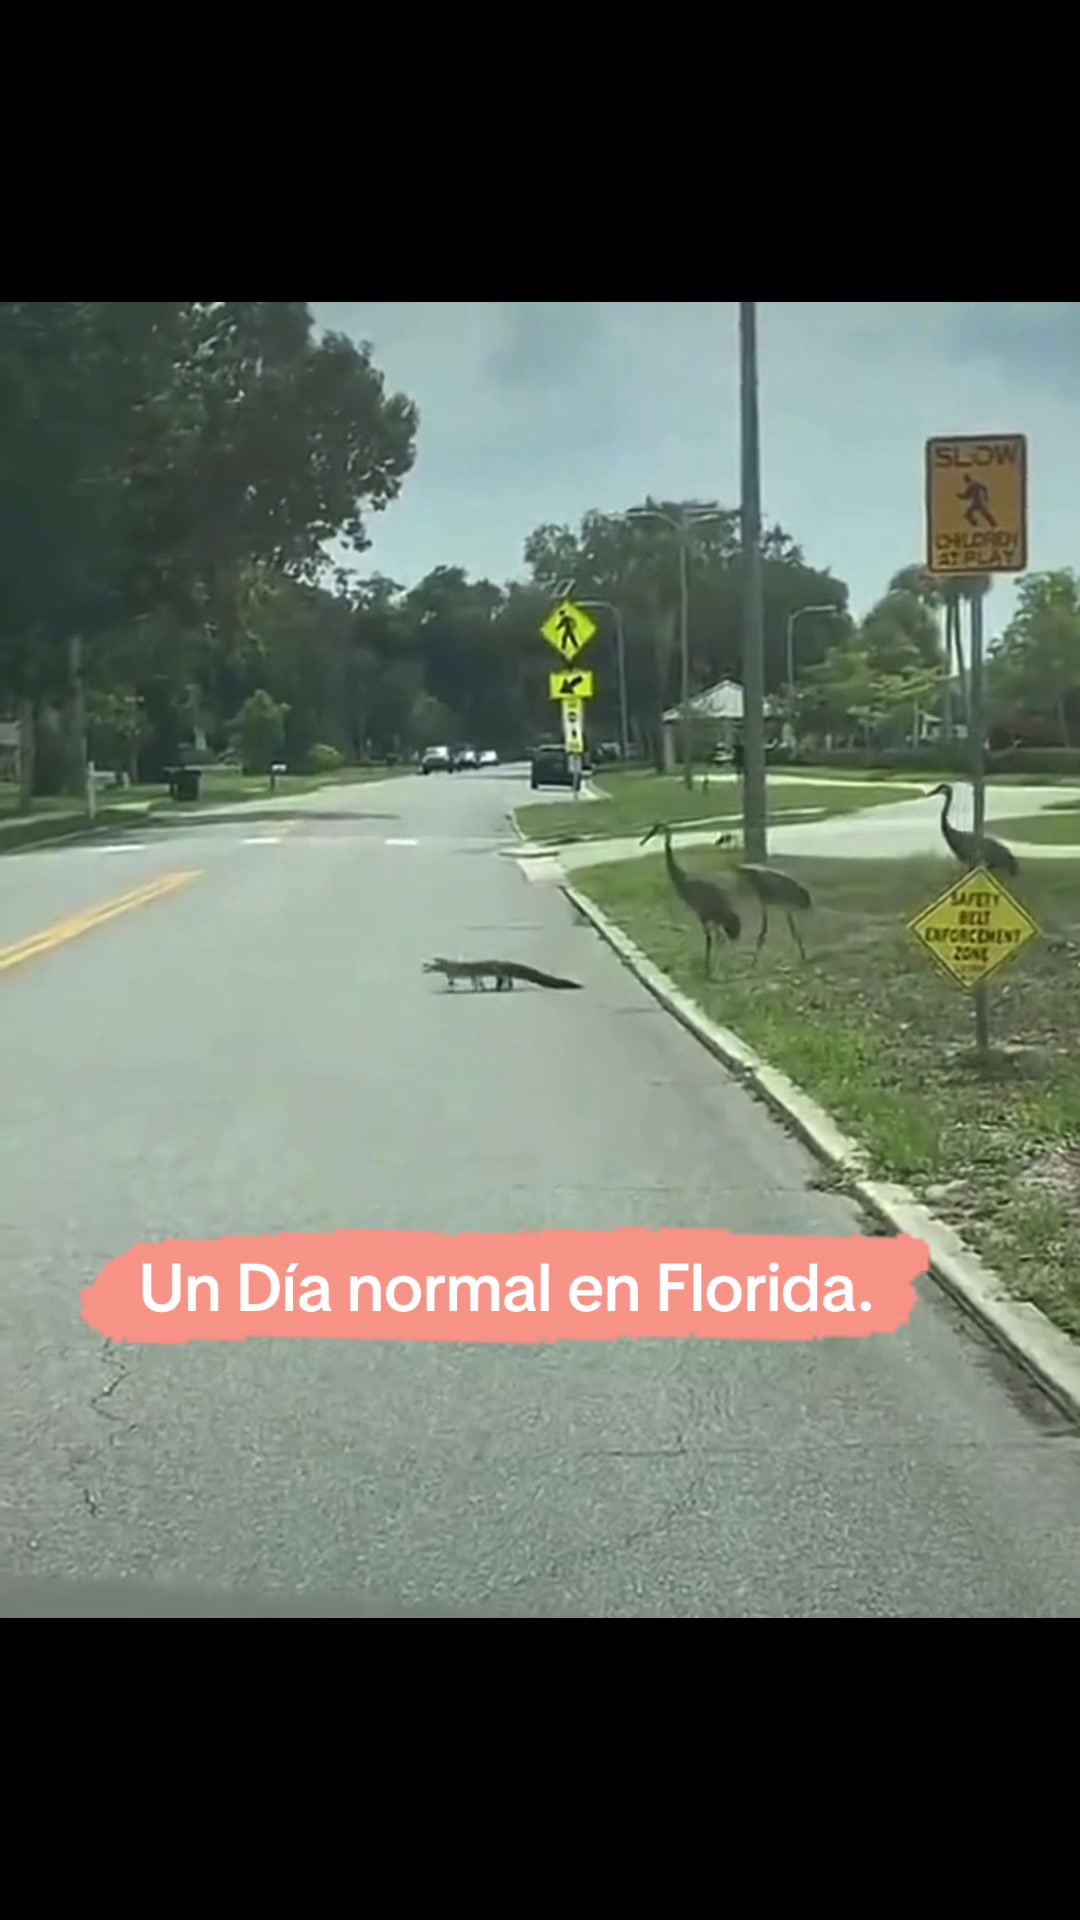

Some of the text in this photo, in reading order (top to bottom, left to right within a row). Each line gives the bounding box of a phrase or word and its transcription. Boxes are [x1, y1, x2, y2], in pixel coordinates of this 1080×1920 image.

[935, 444, 1018, 468] SLOW
[963, 549, 1015, 565] PLAY
[951, 891, 1000, 907] SAFETY
[959, 910, 991, 926] BELT
[925, 927, 1021, 944] ENFORCEMENT
[953, 946, 989, 962] ZONE
